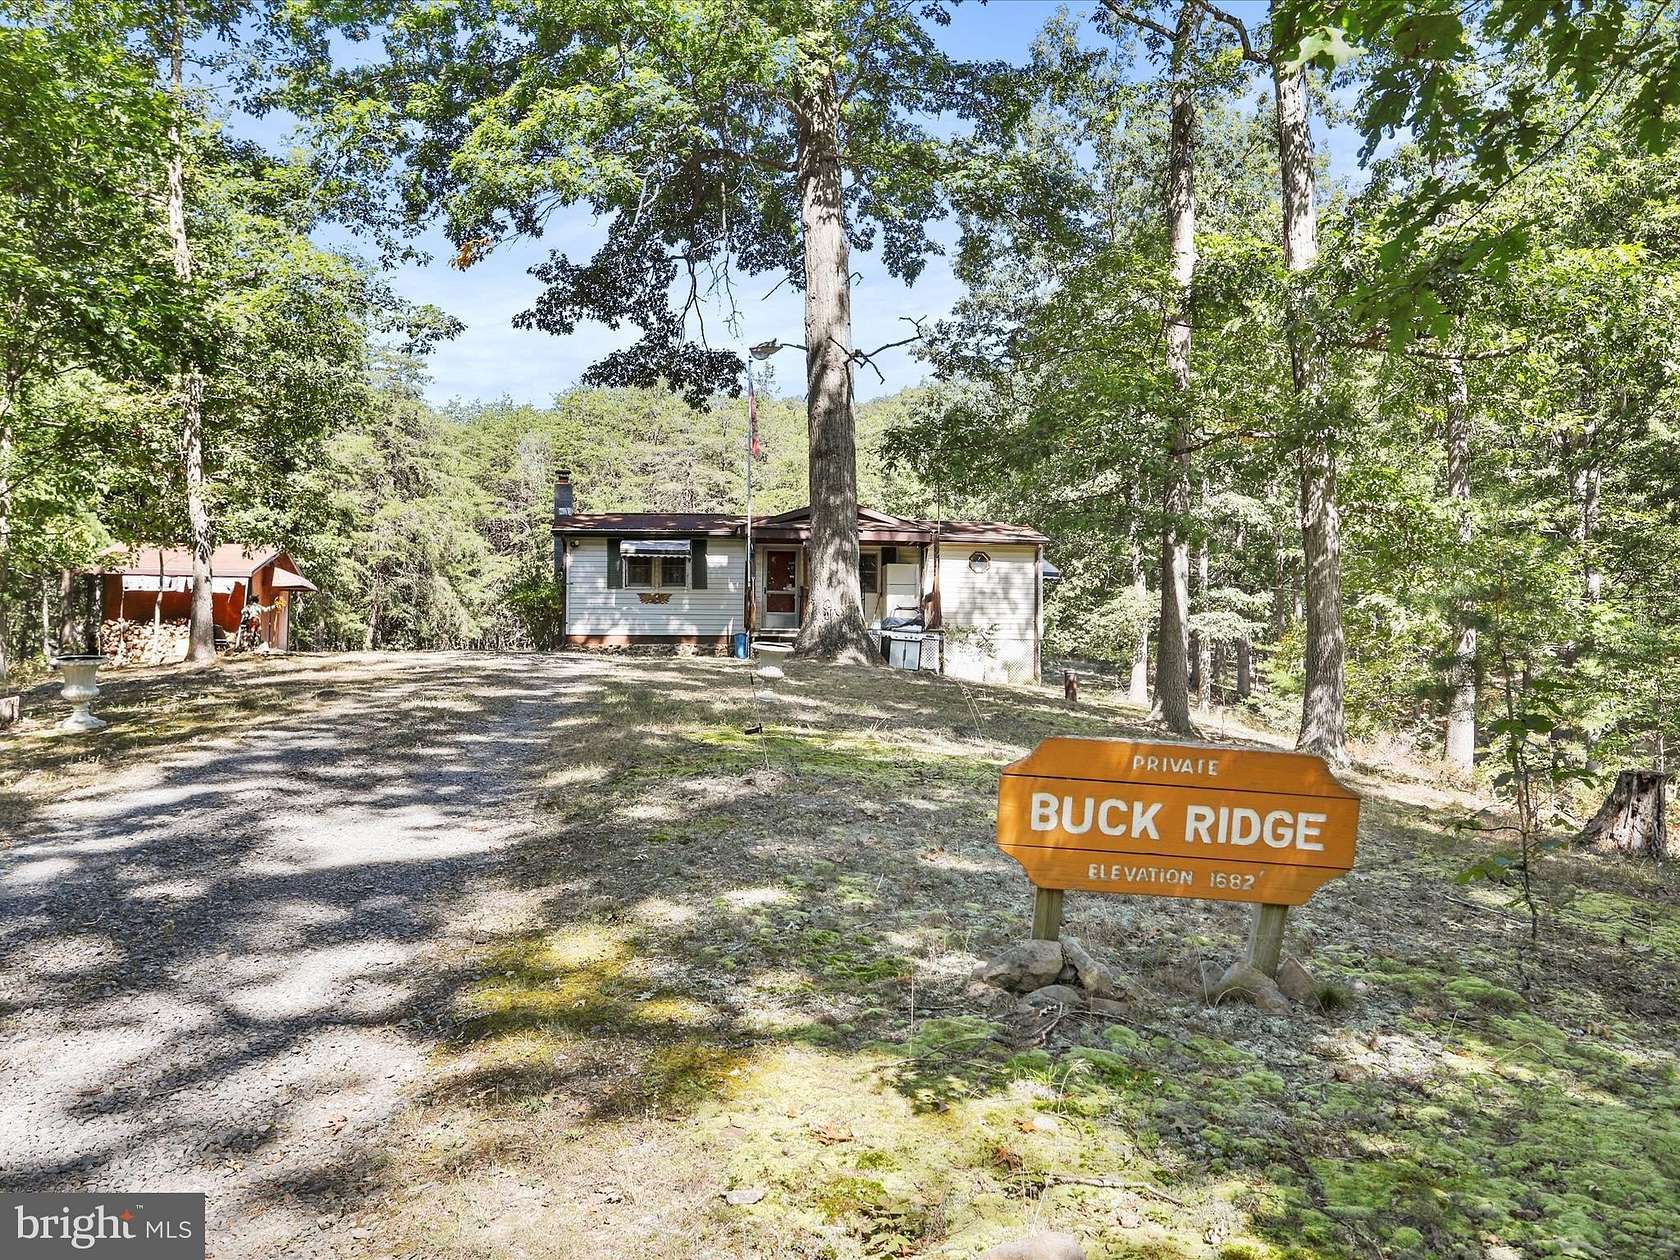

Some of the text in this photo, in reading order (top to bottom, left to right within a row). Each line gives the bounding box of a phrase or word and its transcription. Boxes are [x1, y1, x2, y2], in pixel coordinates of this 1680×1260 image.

[1132, 755, 1219, 777] PRIVATE
[1030, 792, 1328, 851] BUCK RIDGE
[1087, 863, 1193, 886] ELEVATION
